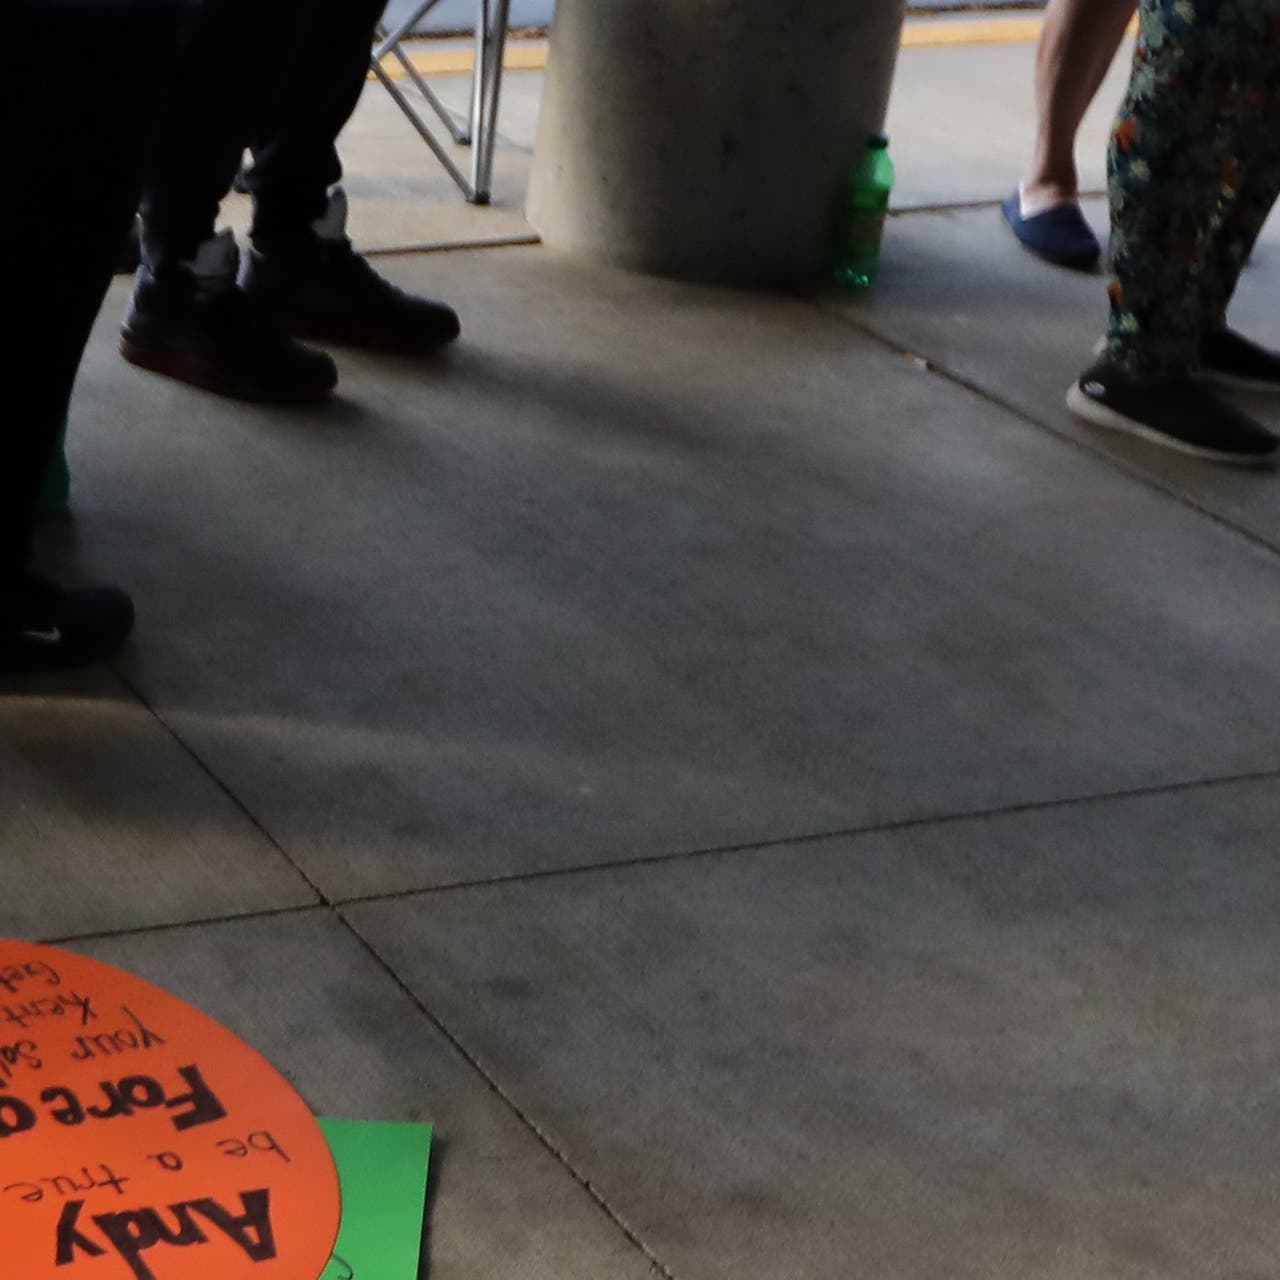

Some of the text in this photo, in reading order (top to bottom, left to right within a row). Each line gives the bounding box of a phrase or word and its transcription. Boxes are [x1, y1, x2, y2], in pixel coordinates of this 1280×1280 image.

[71, 1005, 164, 1061] your
[147, 1152, 182, 1172] a
[215, 1130, 292, 1164] be
[2, 1164, 129, 1204] true
